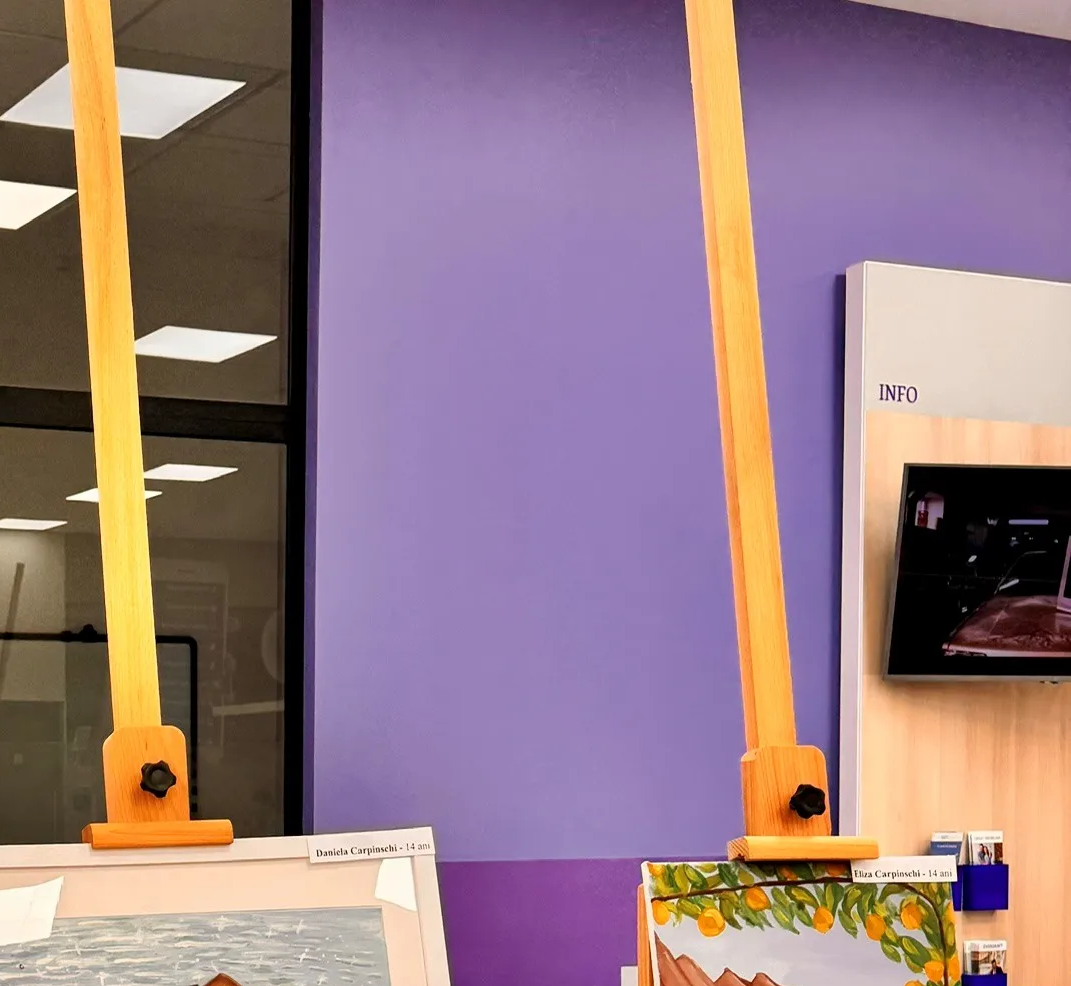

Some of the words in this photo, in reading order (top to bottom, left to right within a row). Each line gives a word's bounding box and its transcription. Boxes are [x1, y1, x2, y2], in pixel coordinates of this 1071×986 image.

[878, 383, 918, 404] INFO
[315, 847, 349, 858] Daniela
[350, 843, 398, 856] Carpinschi
[406, 842, 416, 851] 14
[853, 869, 873, 878] Eliza
[874, 869, 921, 880] Carpinschi
[928, 869, 938, 878] 14
[939, 869, 953, 878] ani
